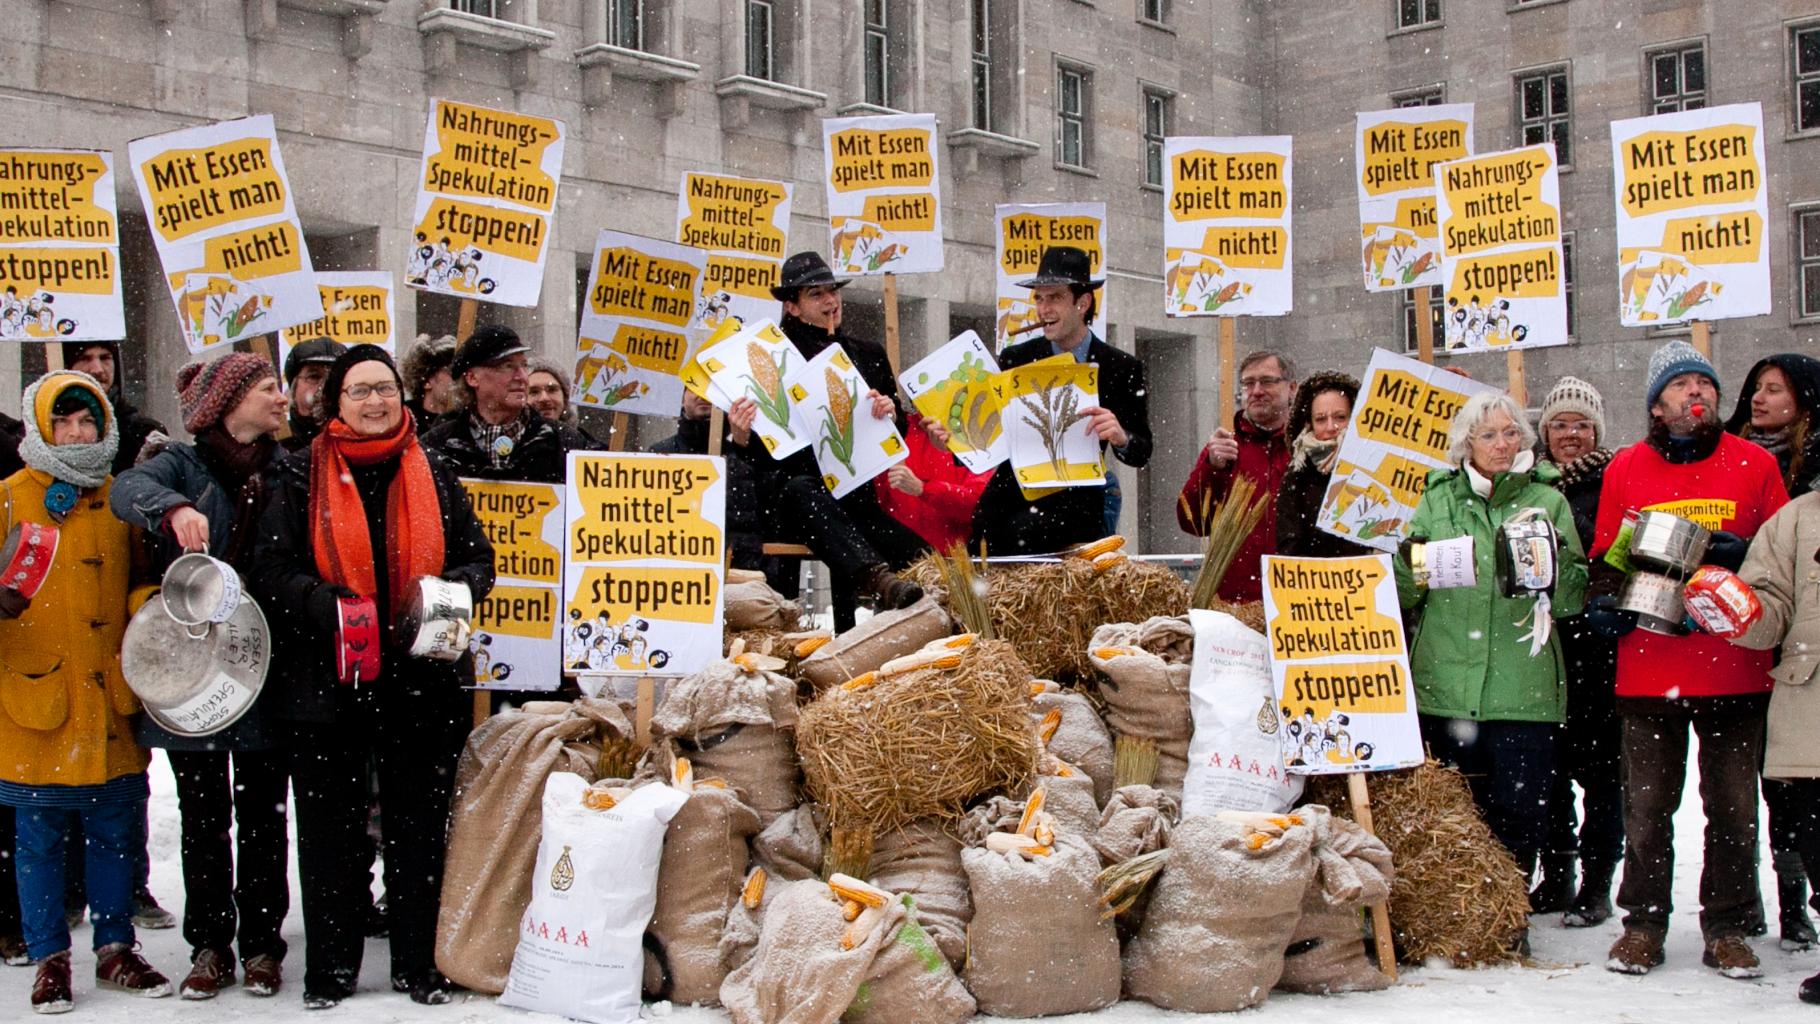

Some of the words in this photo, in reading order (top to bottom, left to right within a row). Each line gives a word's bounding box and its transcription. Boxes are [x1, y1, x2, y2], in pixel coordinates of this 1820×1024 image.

[442, 105, 551, 147] Nahrungs-
[1371, 129, 1406, 155] Mit
[1413, 127, 1461, 150] Essen
[454, 141, 531, 170] mittel-
[838, 134, 872, 156] Mit
[879, 134, 924, 154] Essen
[1632, 139, 1676, 169] Mit
[1685, 135, 1747, 163] Essen
[0, 157, 98, 185] ahrungs-
[151, 156, 200, 192] Mit
[205, 148, 266, 180] Essen
[429, 162, 549, 204] Spekulation
[835, 159, 885, 186] spielt
[892, 161, 930, 179] man
[1180, 158, 1218, 181] Mit
[1226, 157, 1277, 180] Essen
[1367, 157, 1420, 188] spielt
[1448, 160, 1545, 191] Nahrungs-
[1, 187, 83, 209] mittel-
[691, 178, 780, 207] Nahrungs-
[1175, 186, 1231, 215] spielt
[1239, 190, 1282, 209] man
[1465, 187, 1532, 219] mittel-
[1628, 171, 1694, 208] spielt
[1703, 168, 1755, 194] man
[158, 188, 224, 231] spielt
[229, 180, 280, 210] man
[702, 205, 765, 227] mittel-
[877, 197, 929, 221] nicht!
[1410, 202, 1436, 227] nic
[0, 215, 109, 237] ekulation
[437, 205, 540, 246] stoppen!
[683, 224, 781, 253] Spekulation
[1009, 220, 1043, 241] Mit
[1049, 220, 1094, 240] Essen
[1448, 214, 1554, 253] Spekulation
[1682, 217, 1751, 252] nicht!
[222, 228, 290, 269] nicht!
[1005, 244, 1045, 269] spiel
[1219, 231, 1278, 256] nicht!
[605, 252, 640, 280] Mit
[646, 261, 691, 290] Essen
[704, 263, 776, 289] oppen!
[1464, 251, 1556, 292] stoppen!
[595, 284, 646, 309] spielt
[652, 295, 690, 318] man
[347, 320, 386, 334] man
[626, 333, 679, 360] nicht!
[1377, 374, 1419, 409] Mit
[1361, 407, 1422, 442] spielt
[583, 461, 708, 495] Nahrungs-
[463, 486, 549, 519] hrungs-
[601, 497, 690, 523] mittel-
[576, 528, 715, 559] Spekulation
[592, 573, 711, 611] stoppen!
[1274, 563, 1378, 594] Nahrungs-
[1291, 596, 1366, 621] mittel-
[1276, 626, 1396, 658] Spekulation
[1295, 665, 1401, 706] stoppen!
